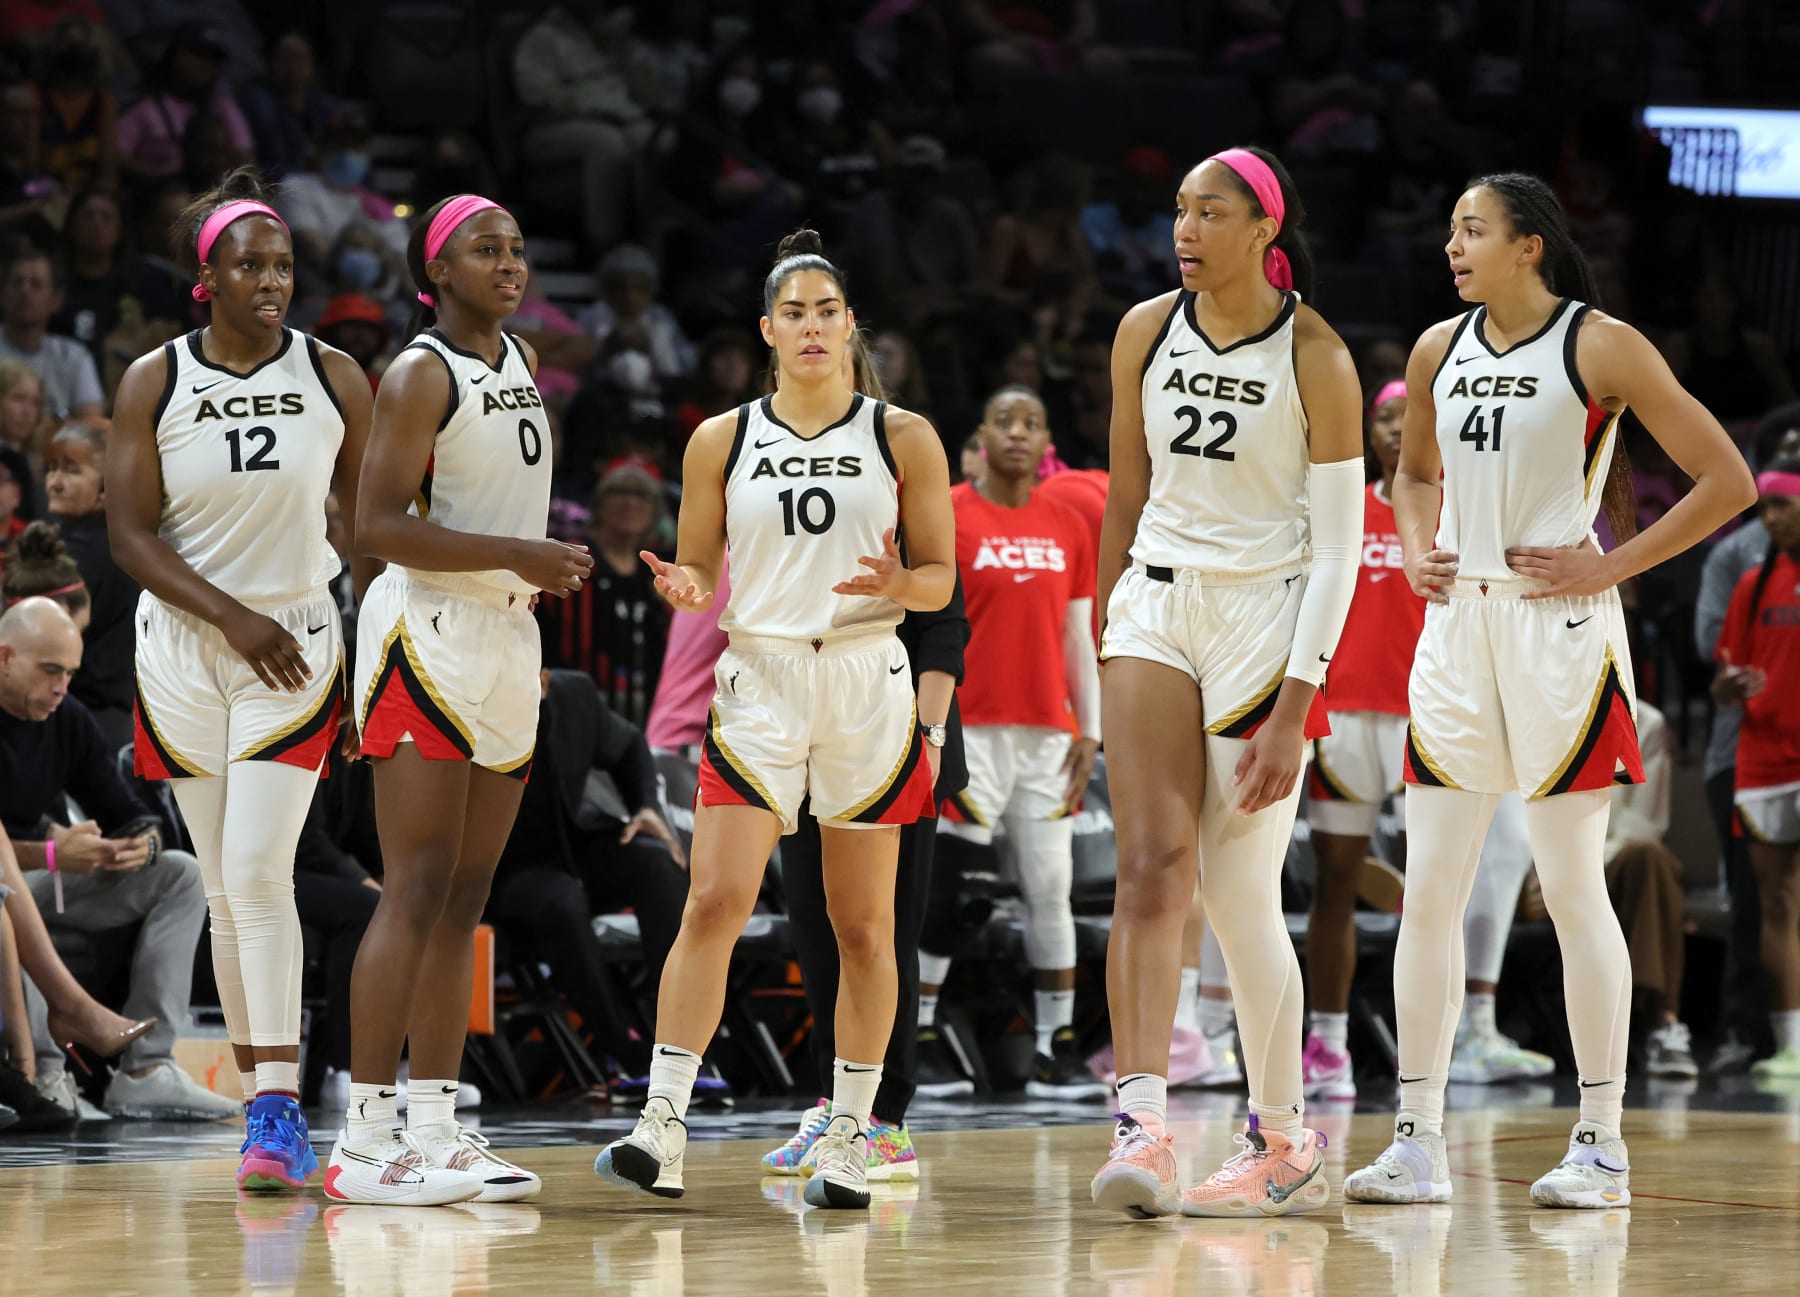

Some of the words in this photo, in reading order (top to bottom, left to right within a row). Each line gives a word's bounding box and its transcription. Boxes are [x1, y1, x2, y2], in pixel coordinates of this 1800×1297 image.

[483, 386, 542, 416] ACES
[1162, 368, 1267, 406] ACES
[1447, 376, 1540, 399] ACES
[193, 393, 305, 423] ACES
[518, 418, 542, 466] 0
[1170, 405, 1238, 462] 22
[1459, 405, 1506, 452] 41
[225, 426, 280, 472] 12
[749, 456, 863, 481] ACES
[778, 487, 836, 536] 10
[972, 544, 1067, 573] ACES
[1360, 541, 1405, 569] CE
